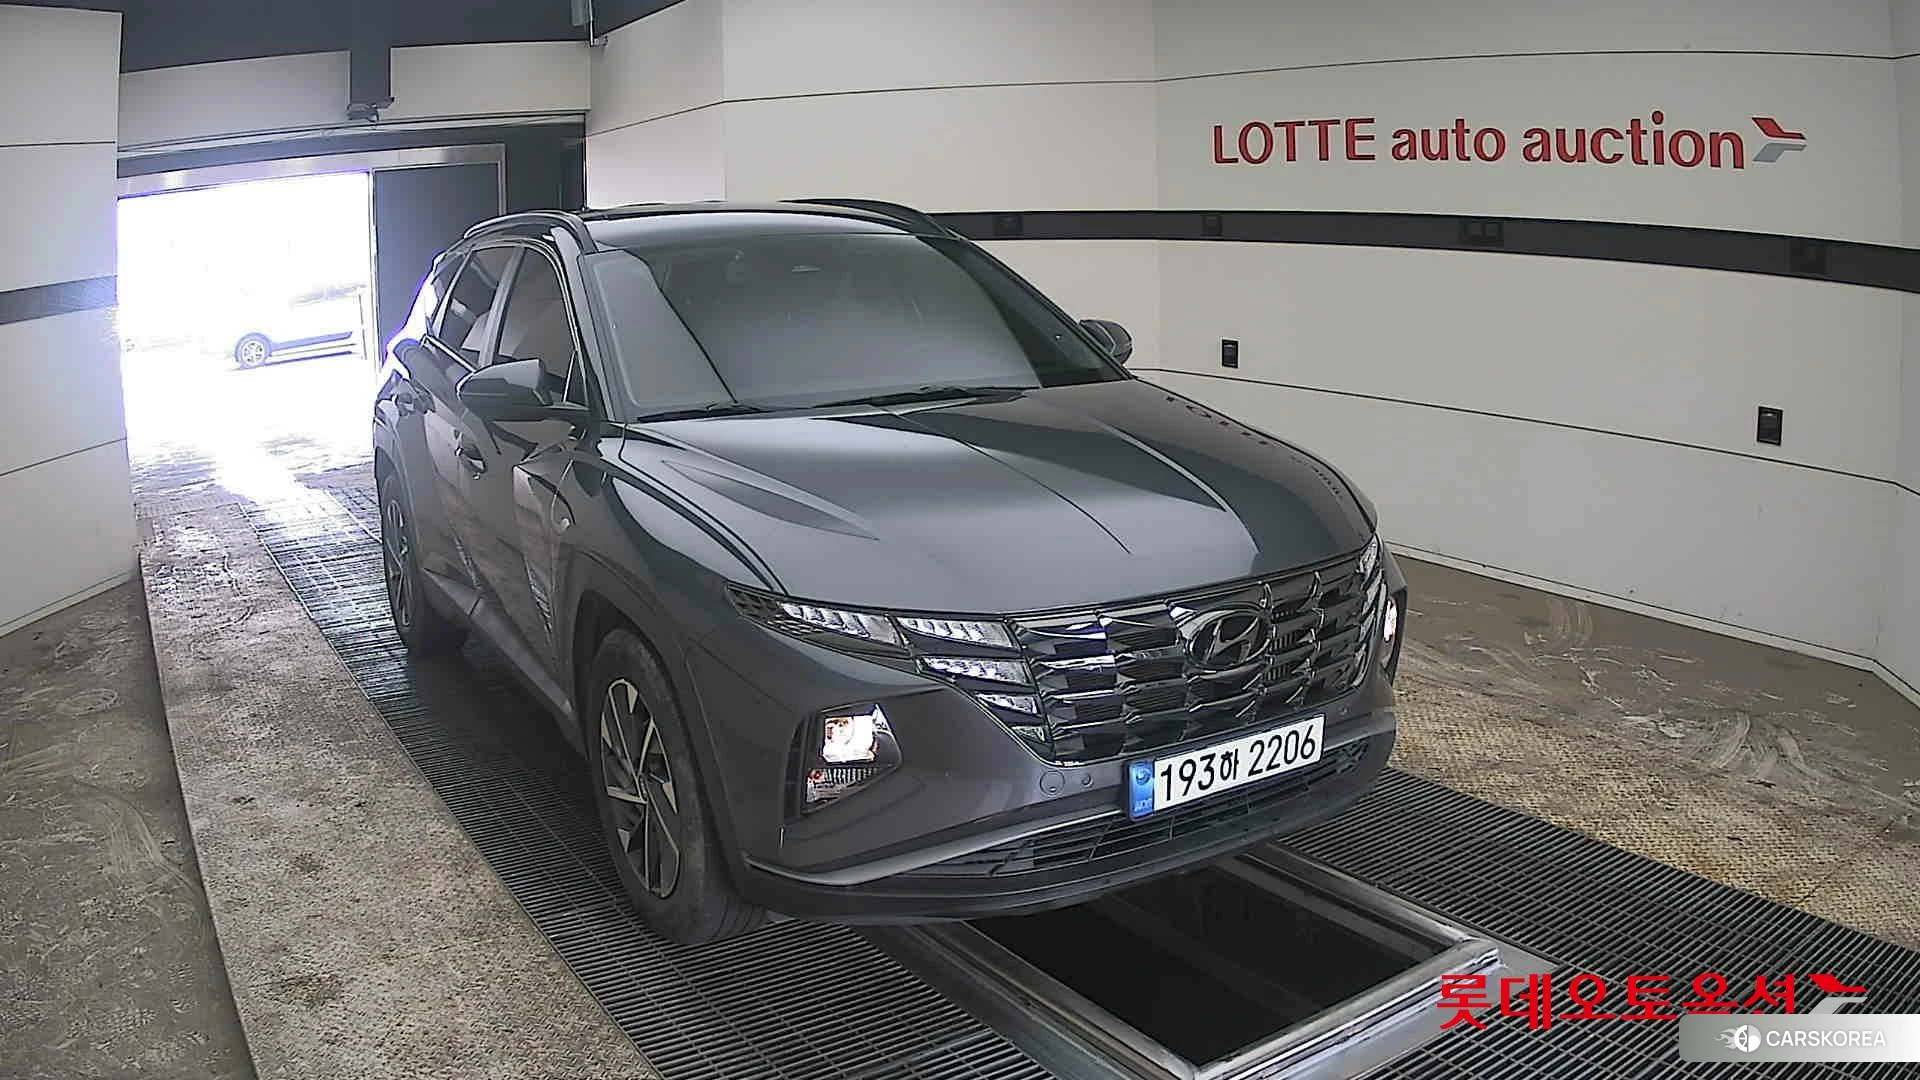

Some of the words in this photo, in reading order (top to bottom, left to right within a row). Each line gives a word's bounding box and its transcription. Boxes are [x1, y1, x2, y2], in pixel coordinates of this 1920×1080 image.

[1213, 117, 1376, 165] LOTTE
[1391, 119, 1507, 161] auto
[1522, 111, 1745, 170] auction
[1160, 748, 1239, 802] 193하
[1248, 724, 1316, 777] 2206
